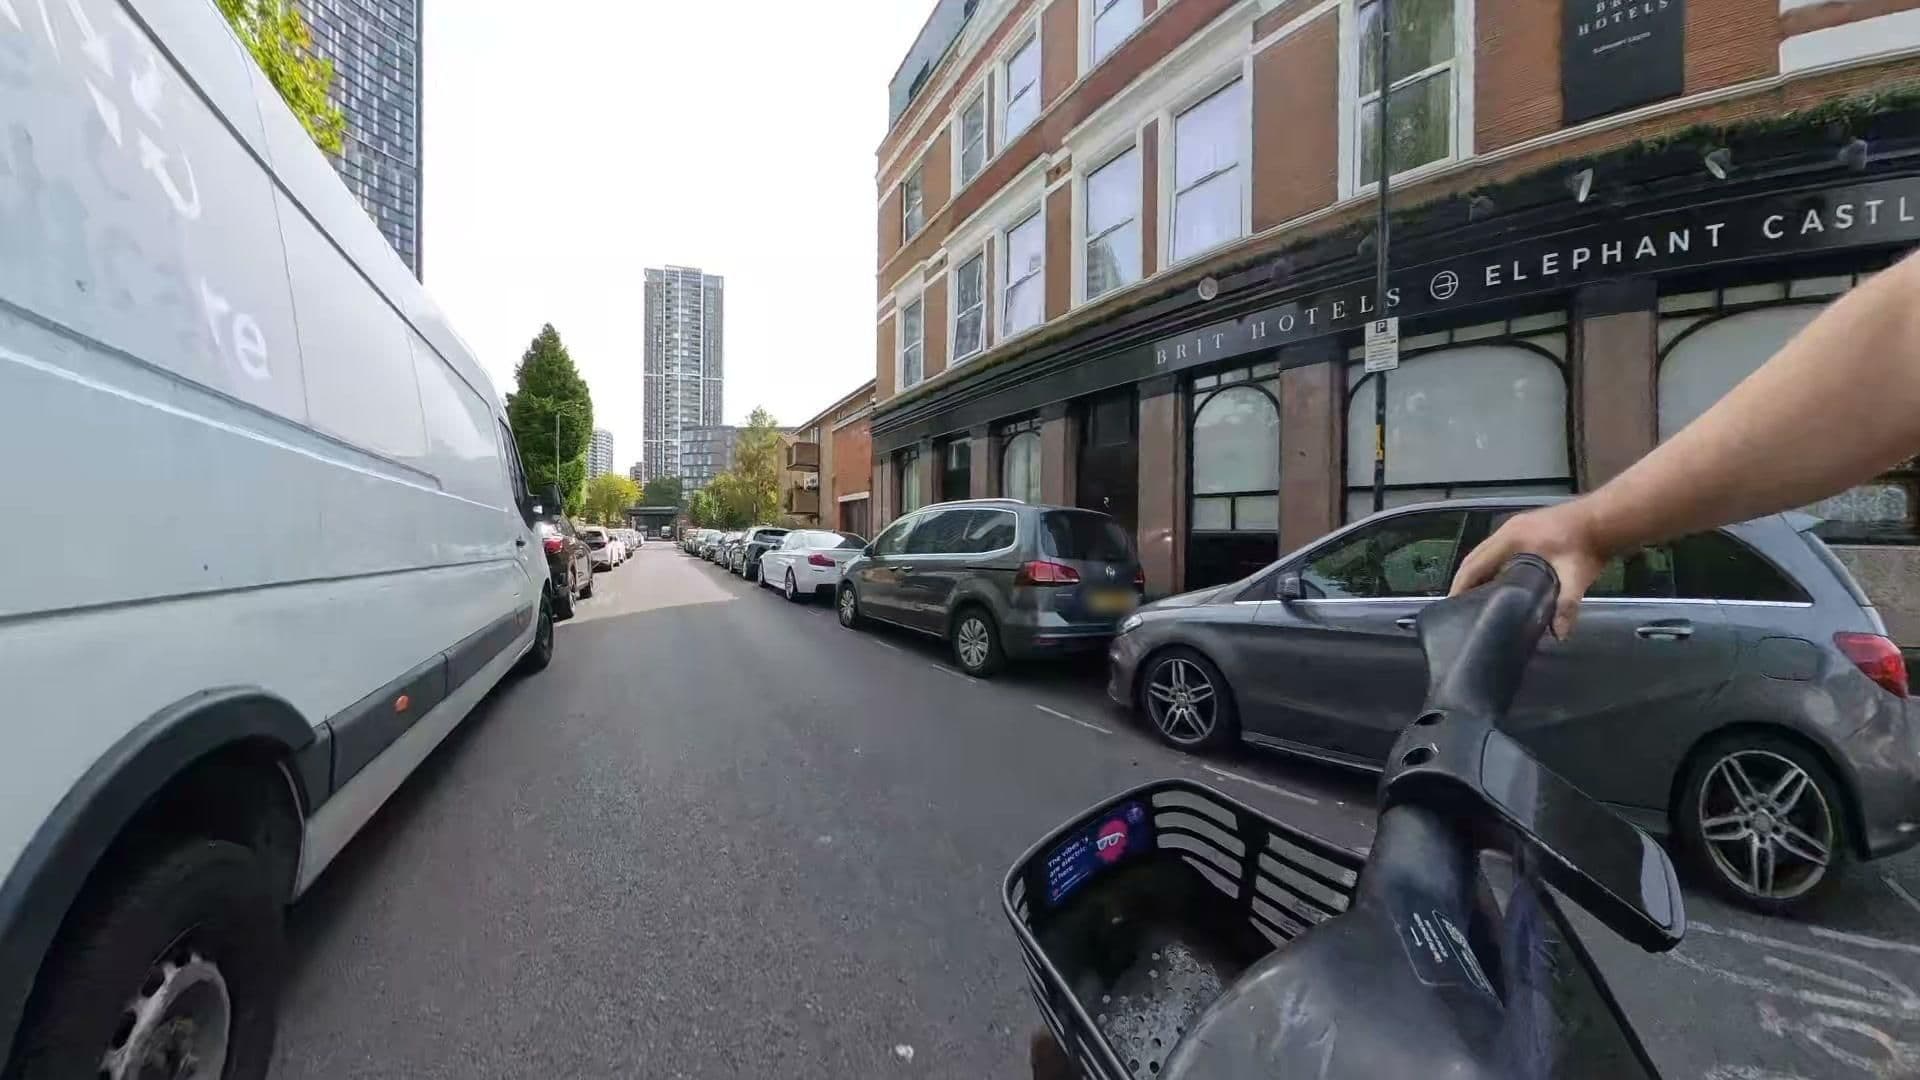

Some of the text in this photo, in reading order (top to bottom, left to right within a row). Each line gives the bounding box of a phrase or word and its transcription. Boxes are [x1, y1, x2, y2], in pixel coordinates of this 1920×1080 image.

[1578, 0, 1668, 36] HOTELS
[1156, 332, 1224, 365] BRIT
[1251, 287, 1400, 341] HOTELS
[1485, 222, 1726, 287] ELEPHANT
